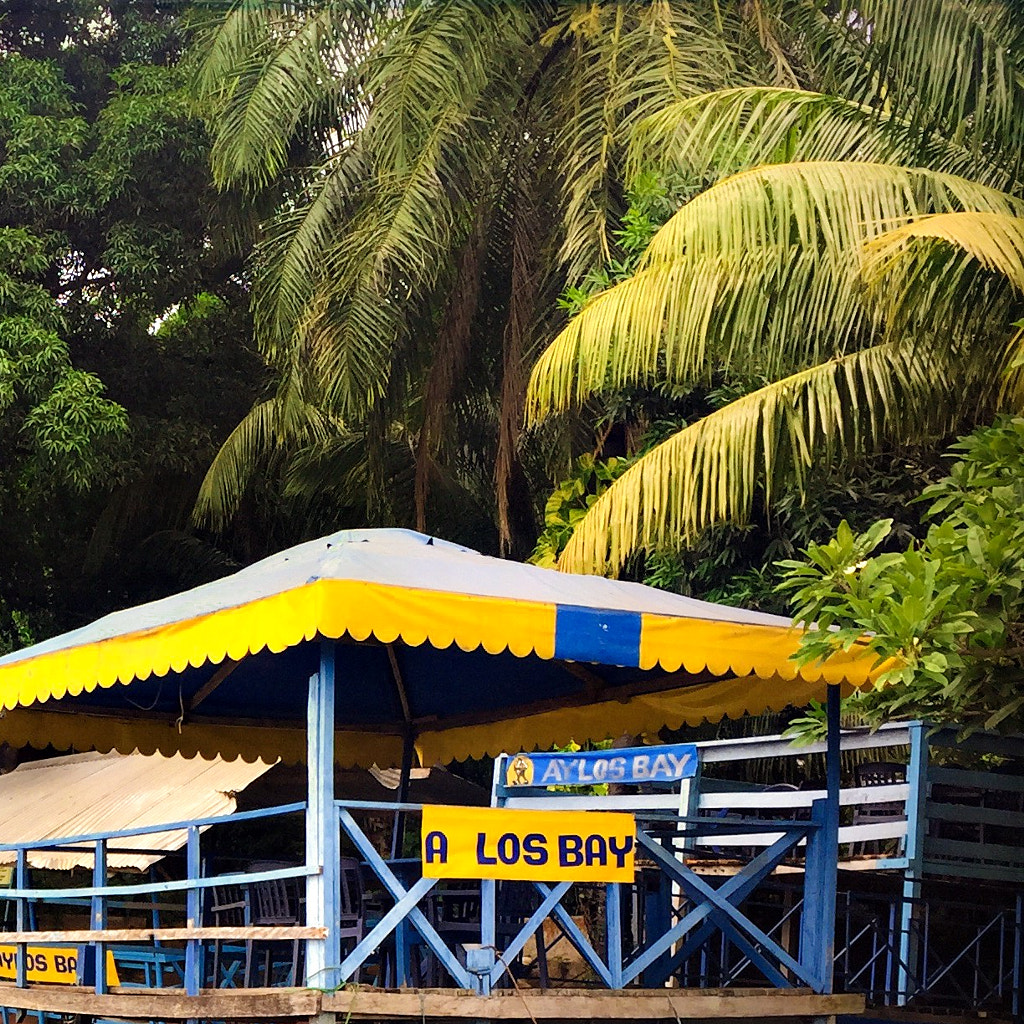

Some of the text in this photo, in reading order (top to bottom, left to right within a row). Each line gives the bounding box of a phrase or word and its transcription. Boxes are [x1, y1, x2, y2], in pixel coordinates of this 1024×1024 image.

[633, 753, 692, 779] BAY
[425, 831, 635, 868] A LOS BAY
[54, 955, 77, 974] BA
